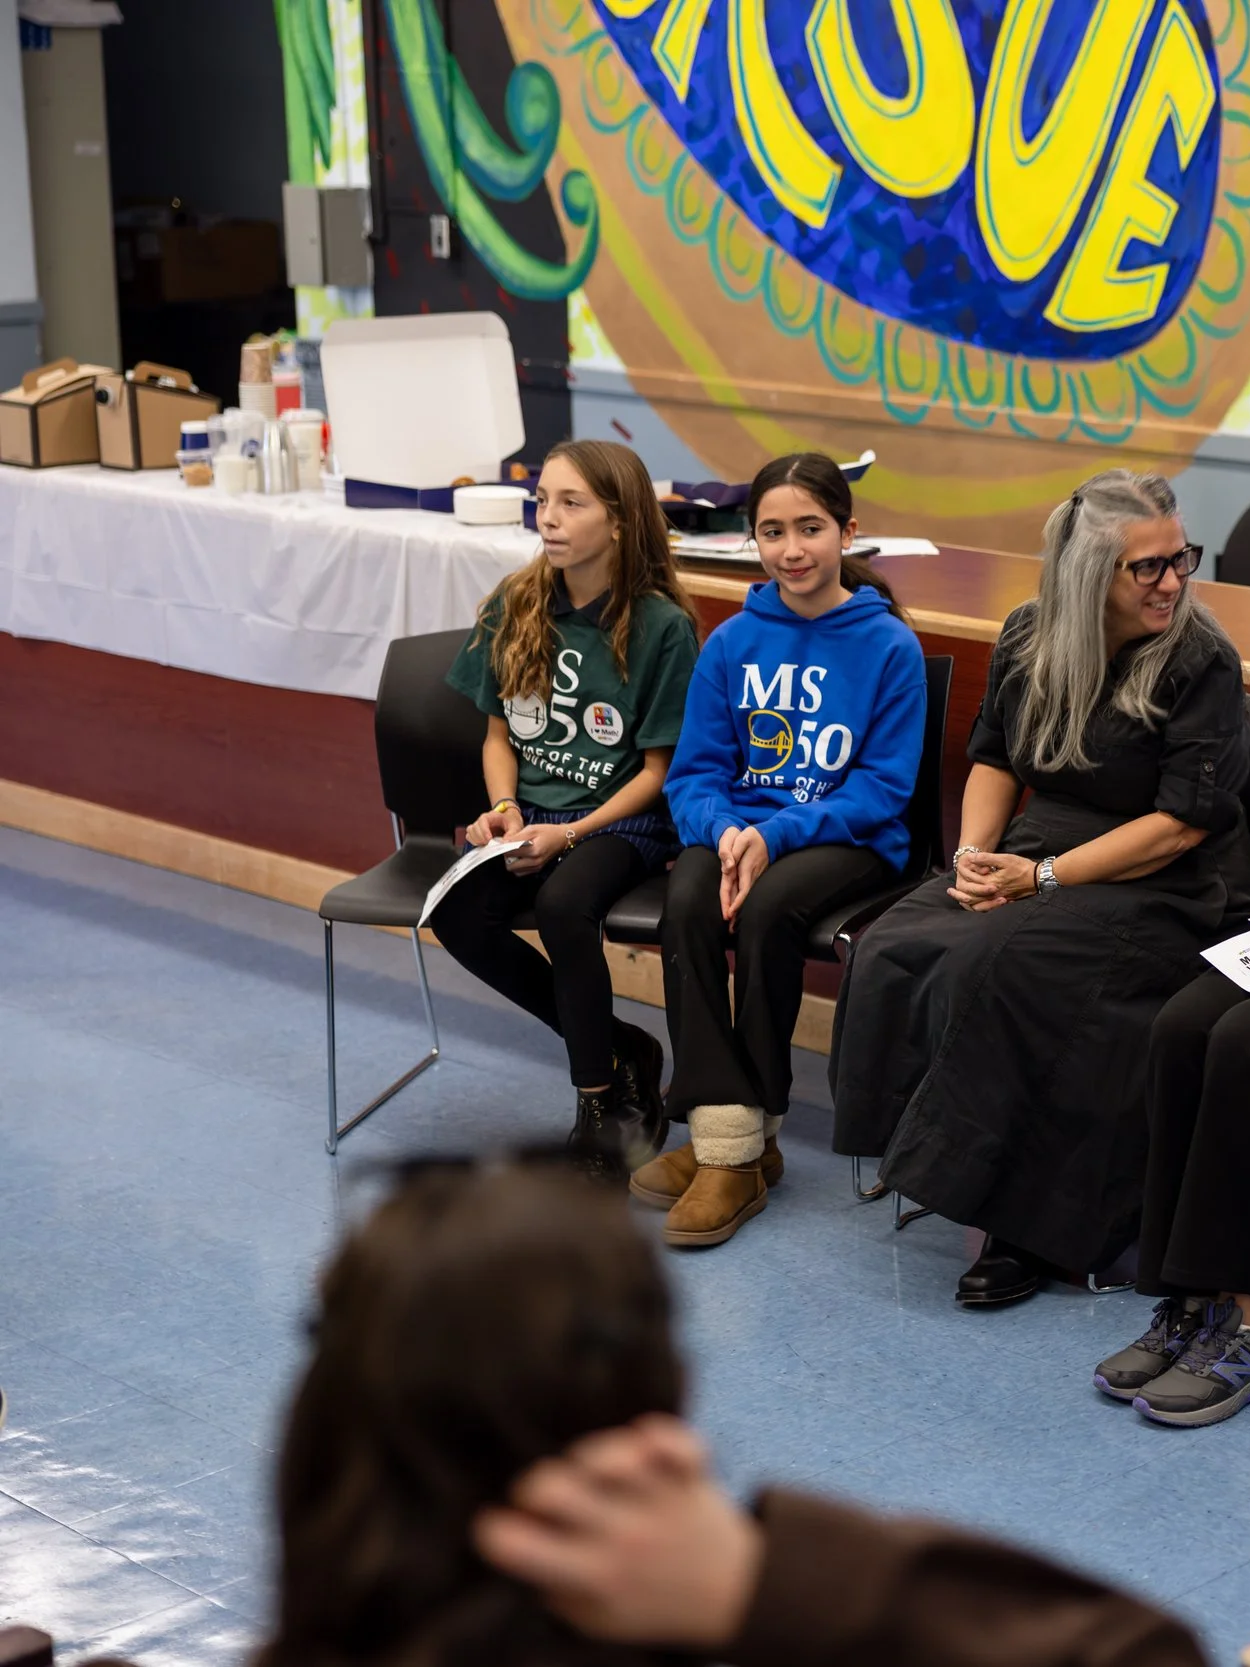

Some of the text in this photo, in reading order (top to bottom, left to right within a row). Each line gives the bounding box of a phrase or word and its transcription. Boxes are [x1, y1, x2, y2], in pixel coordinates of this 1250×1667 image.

[738, 663, 828, 713] MS
[549, 751, 572, 763] OF
[579, 757, 614, 776] THE
[795, 719, 853, 771] 50
